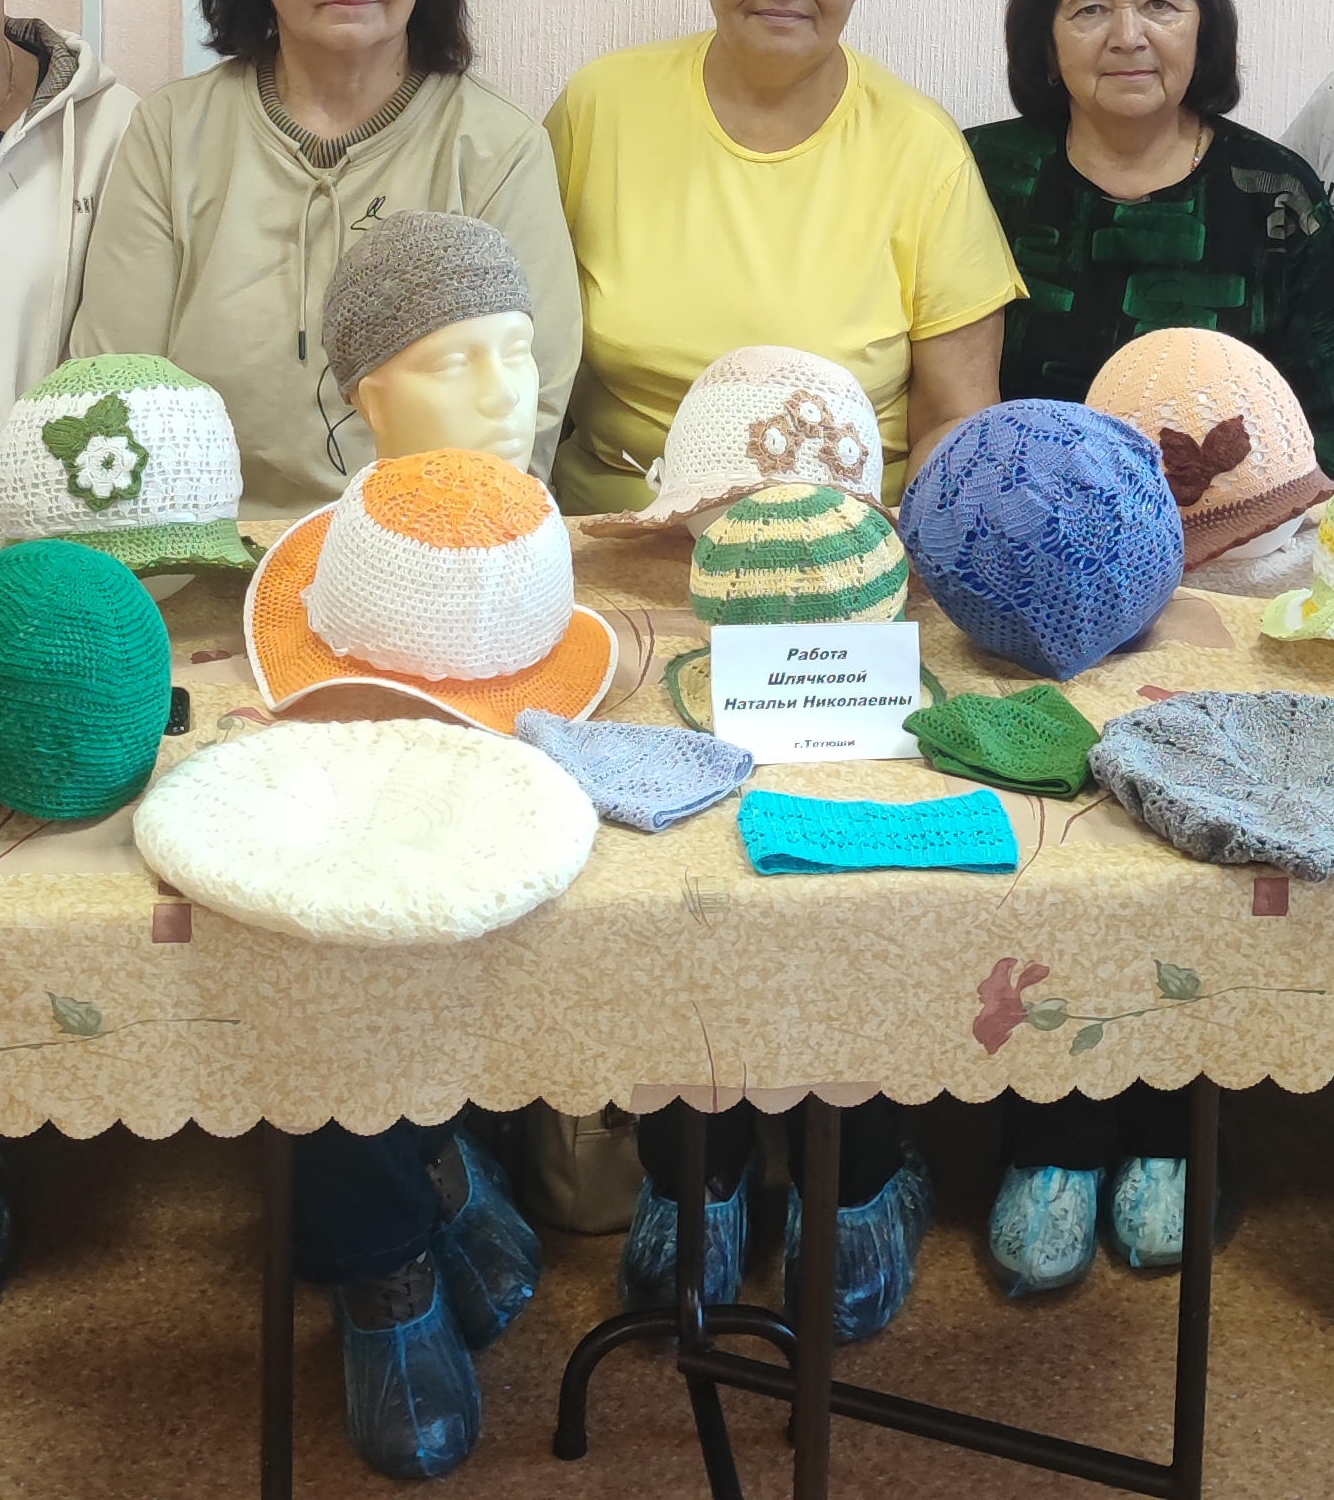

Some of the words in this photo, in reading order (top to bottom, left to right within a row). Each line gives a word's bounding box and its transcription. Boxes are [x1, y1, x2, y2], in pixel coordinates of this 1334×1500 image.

[786, 647, 848, 662] Работа
[767, 669, 867, 686] Шлячковой
[724, 697, 797, 711] Натальи
[803, 694, 913, 709] Николаевны
